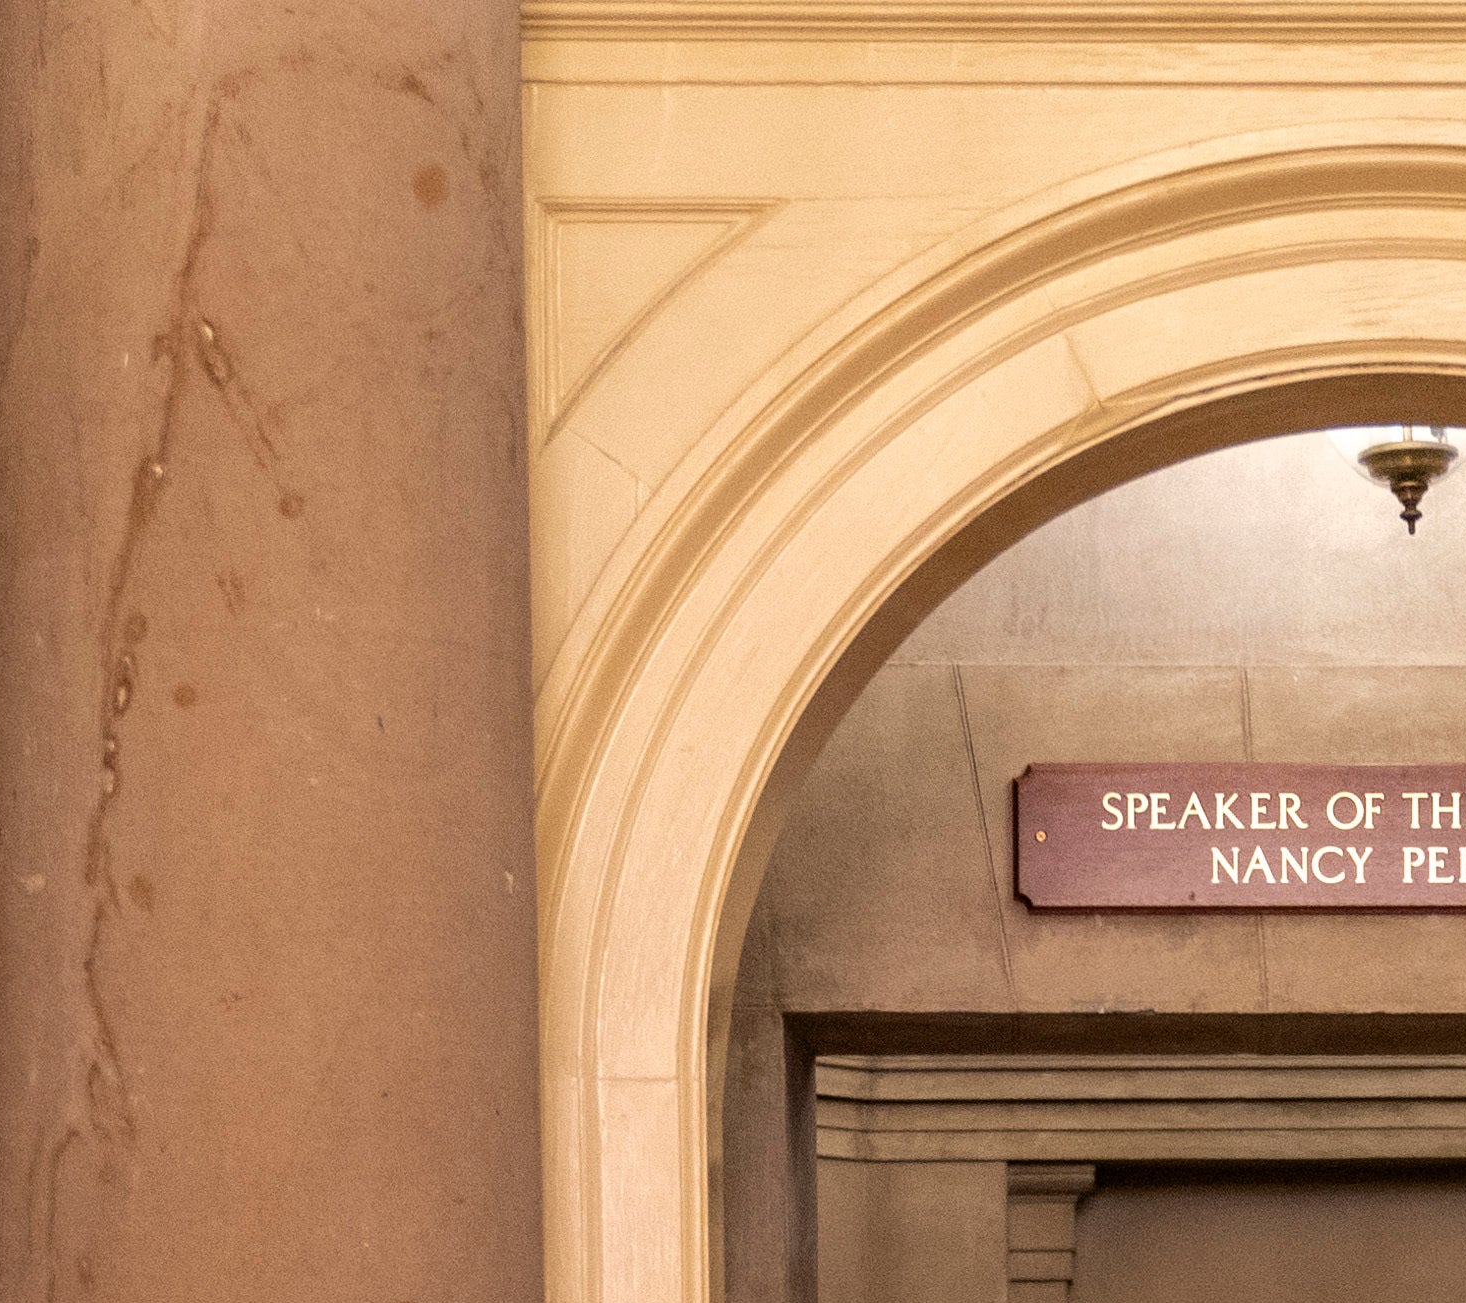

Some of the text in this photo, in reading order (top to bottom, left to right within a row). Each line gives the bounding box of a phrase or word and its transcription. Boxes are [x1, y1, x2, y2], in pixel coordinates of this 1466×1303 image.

[1102, 792, 1308, 831] SPEAKER
[1326, 792, 1385, 831] OF
[1210, 846, 1374, 884] NANCY
